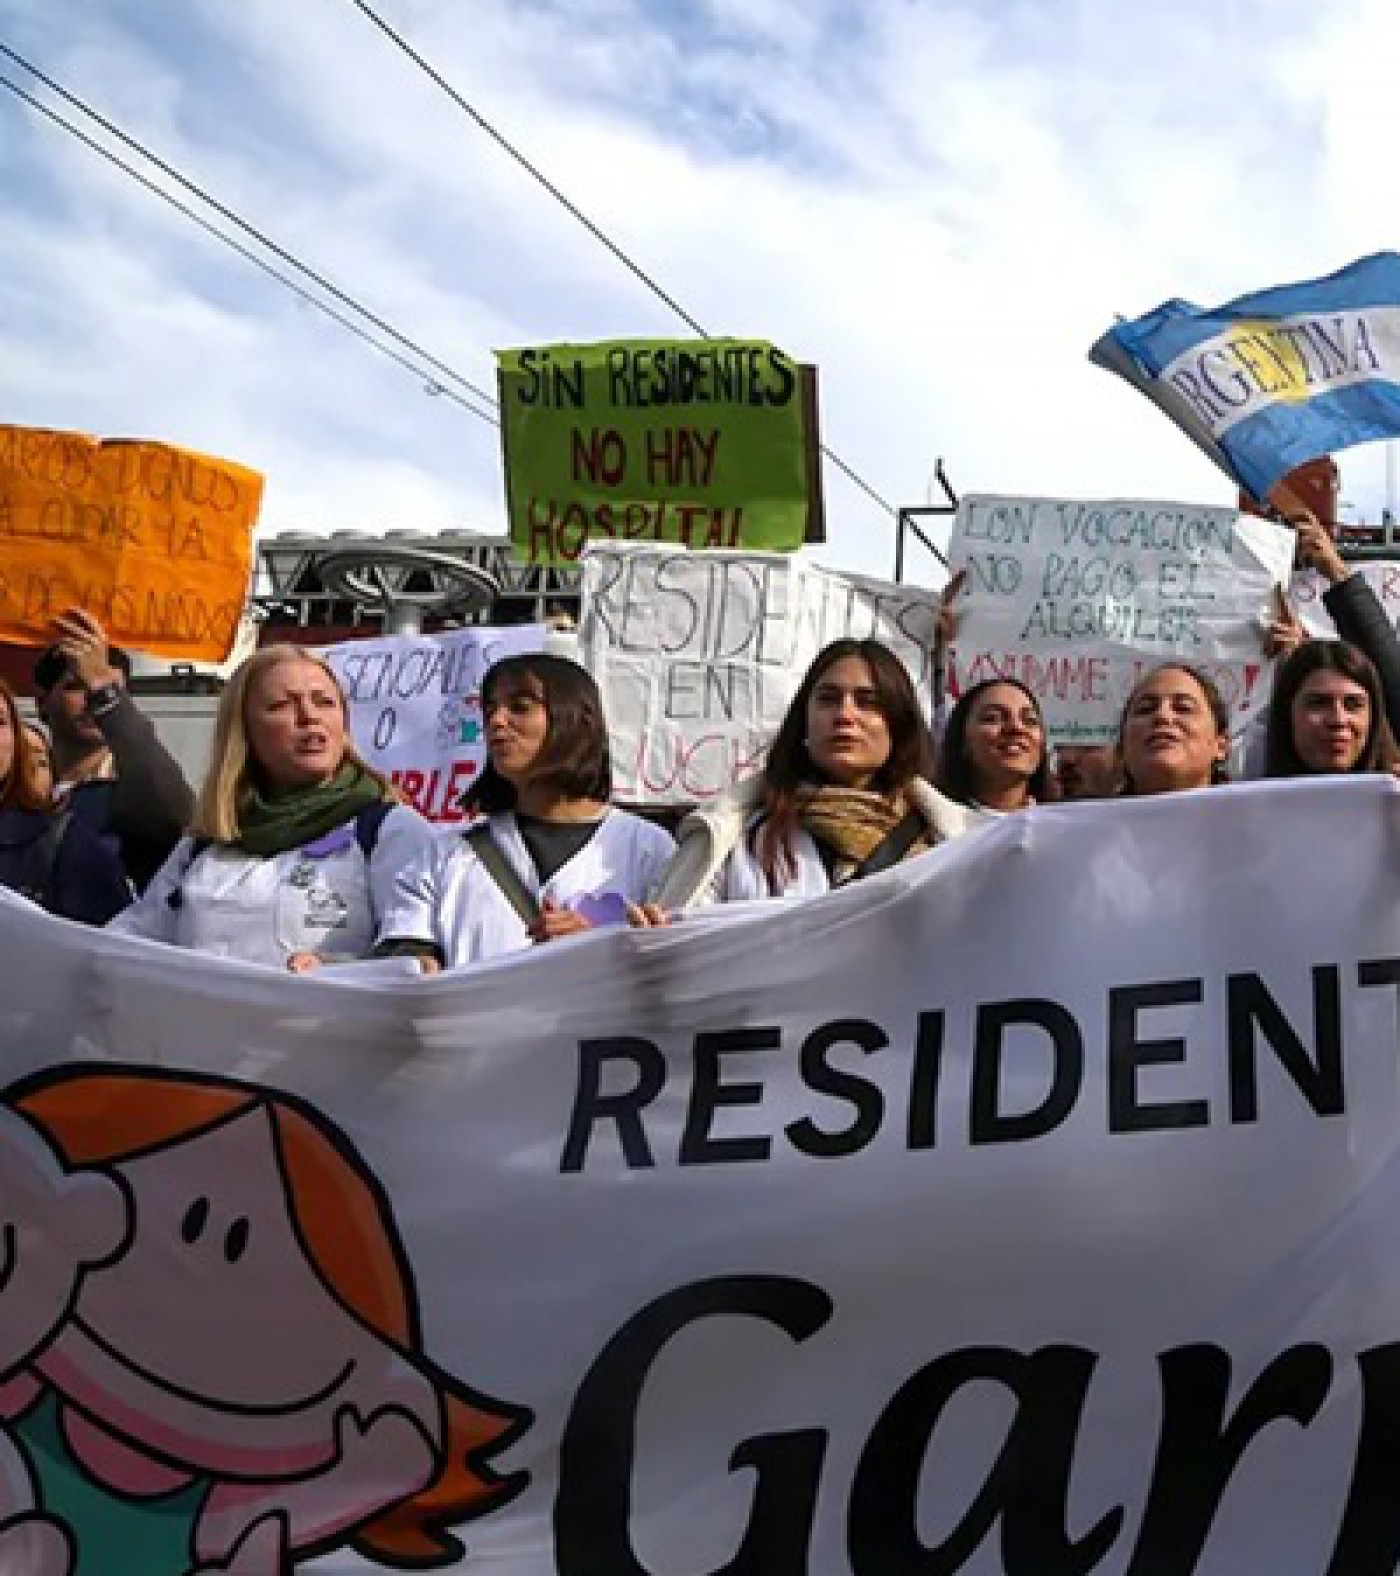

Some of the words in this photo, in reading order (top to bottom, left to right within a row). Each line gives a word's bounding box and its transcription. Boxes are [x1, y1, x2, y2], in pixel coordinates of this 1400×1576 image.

[1172, 317, 1379, 428] RGENTINA
[569, 425, 627, 485] NO
[645, 425, 720, 487] HAY
[1042, 553, 1140, 600] PAGO
[1157, 562, 1216, 601] EL
[664, 660, 734, 721] EN
